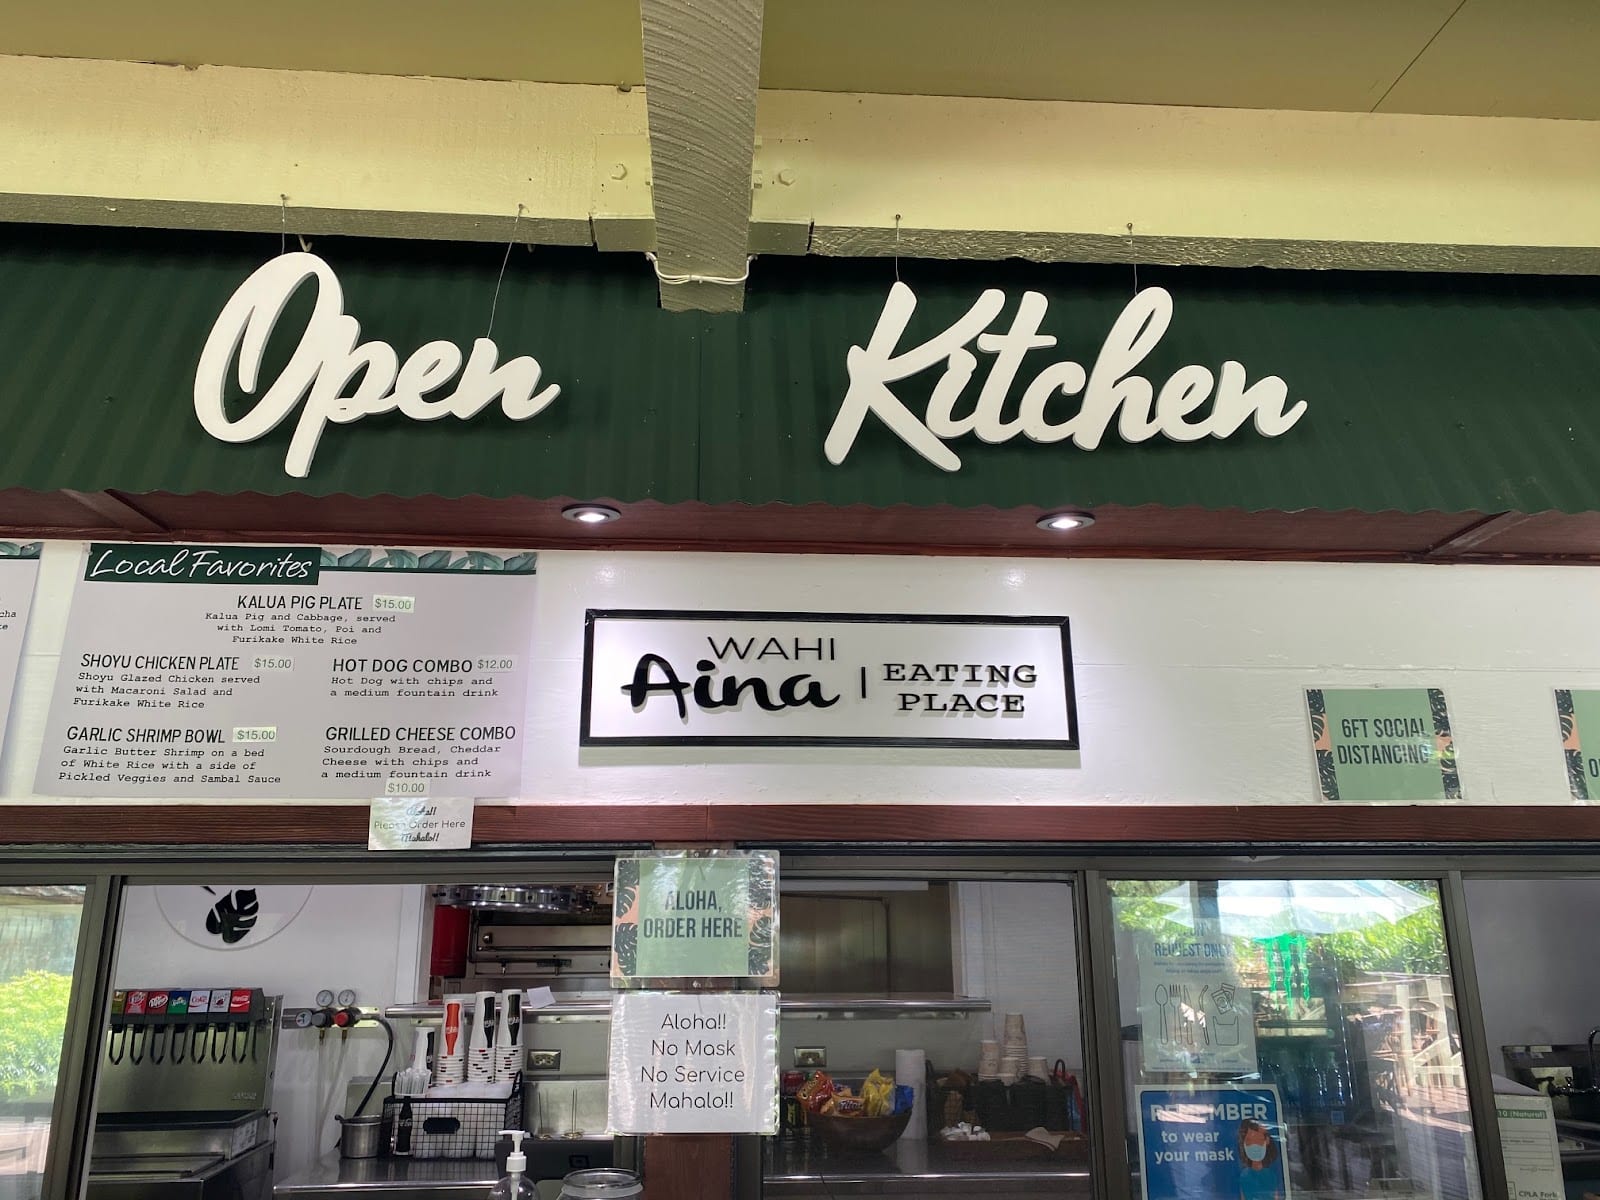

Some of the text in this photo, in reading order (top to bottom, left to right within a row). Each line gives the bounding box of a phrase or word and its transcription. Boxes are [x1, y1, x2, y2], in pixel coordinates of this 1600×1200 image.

[193, 252, 561, 478] Open
[824, 281, 1308, 472] Kitchen
[89, 549, 313, 578] Local Favorites
[237, 595, 363, 610] KALUA PIG PLATE
[374, 598, 412, 610] $15.00
[205, 612, 238, 621] Kalua
[245, 613, 264, 622] Pig
[296, 614, 348, 623] Cabbage,
[356, 615, 396, 623] served
[217, 624, 244, 632] with
[250, 624, 276, 632] Lomi
[283, 626, 328, 634] Tomato,
[362, 626, 382, 634] and
[232, 636, 285, 644] Furikake
[707, 636, 835, 662] WAHI
[80, 654, 240, 671] SHOYU CHICKEN PLATE
[254, 658, 292, 669] $15.00
[333, 658, 473, 673] HOT DOG COMBO
[477, 660, 513, 670] $12.00
[78, 672, 261, 684] Shoyu Glazed Chicken served
[883, 663, 1038, 685] EATING
[331, 677, 353, 685] Hot
[361, 677, 383, 687] Dog
[427, 678, 464, 687] chips
[471, 677, 493, 685] and
[620, 653, 841, 719] Aina
[76, 685, 233, 696] with Macaroni Salad and
[344, 689, 390, 697] medium
[396, 689, 456, 697] fountain
[462, 688, 499, 697] drink
[73, 698, 205, 709] Furikake White Rice
[898, 692, 1026, 713] PLACE
[66, 726, 226, 744] GARLIC SHRIMP BOWL
[326, 726, 516, 742] GRILLED CHEESE COMBO
[1341, 718, 1430, 738] 6FT SOCIAL
[237, 730, 276, 741] $15.00
[63, 746, 108, 756] Garlic
[115, 748, 158, 757] Butter
[164, 748, 205, 759] Shrimp
[211, 749, 226, 757] on
[244, 748, 265, 758] bed
[324, 745, 502, 756] Sourdough Bread, Cheddar
[1337, 745, 1430, 765] DISTANCING
[61, 758, 257, 770] of White Rice with a side of
[322, 758, 479, 768] Cheese with chips and
[58, 772, 281, 785] Pickled Veggies and Sambal Sauce
[336, 770, 382, 779] medium
[388, 770, 449, 779] fountain
[456, 769, 492, 778] drink
[388, 782, 425, 793] $10.00
[442, 820, 466, 828] Here
[664, 889, 723, 913] ALOHA,
[643, 917, 743, 939] ORDER HERE
[661, 1013, 727, 1031] Aloha!!
[651, 1040, 736, 1056] No Mask
[641, 1066, 745, 1083] No Service
[650, 1092, 734, 1110] Mahalo!!
[1162, 1131, 1220, 1143] to wear
[1154, 1148, 1235, 1165] your mask
